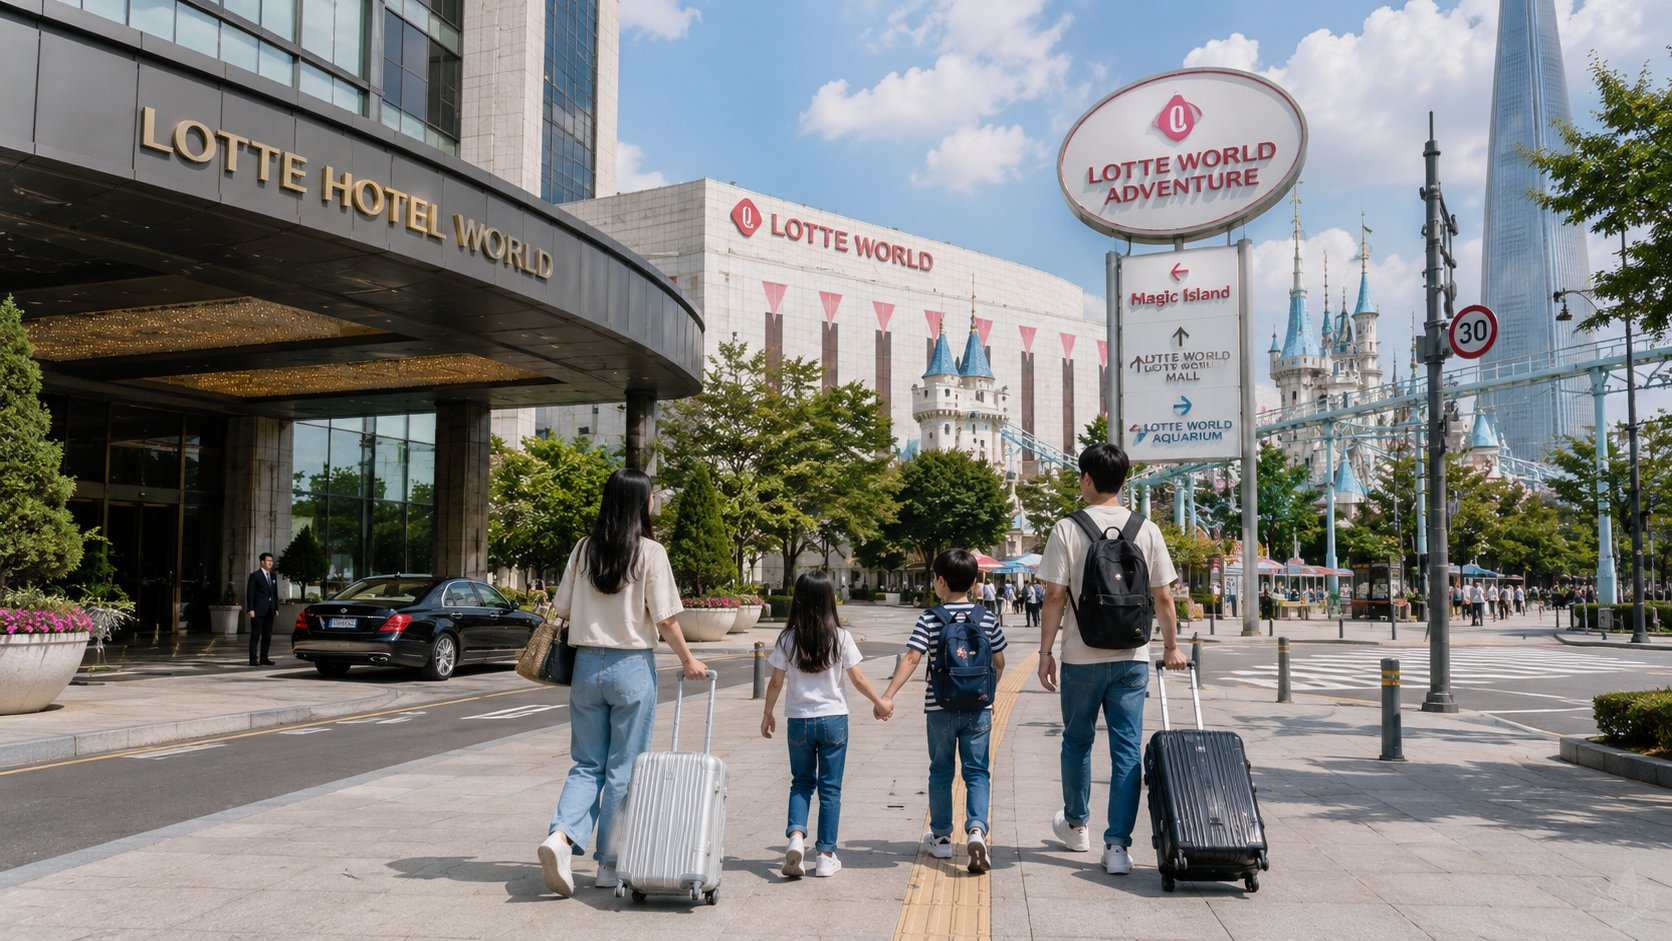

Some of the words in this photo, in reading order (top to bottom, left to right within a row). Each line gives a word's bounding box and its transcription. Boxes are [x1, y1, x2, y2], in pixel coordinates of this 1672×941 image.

[1088, 156, 1171, 185] LOTTE
[1177, 141, 1277, 172] WORLD
[140, 106, 308, 195] LOTTE
[321, 165, 448, 241] HOTEL
[452, 213, 554, 280] WORLD
[1104, 168, 1260, 206] ADVENTURE
[771, 213, 850, 252] LOTTE
[854, 234, 935, 272] WORLD
[1131, 289, 1179, 307] Magic
[1183, 285, 1231, 303] Island
[1459, 319, 1487, 345] 30
[1183, 350, 1231, 362] WORLD
[1165, 371, 1200, 382] MALL
[1144, 422, 1183, 433] LOTTE
[1187, 420, 1233, 431] WORLD
[1152, 431, 1223, 444] AQUARIUM
